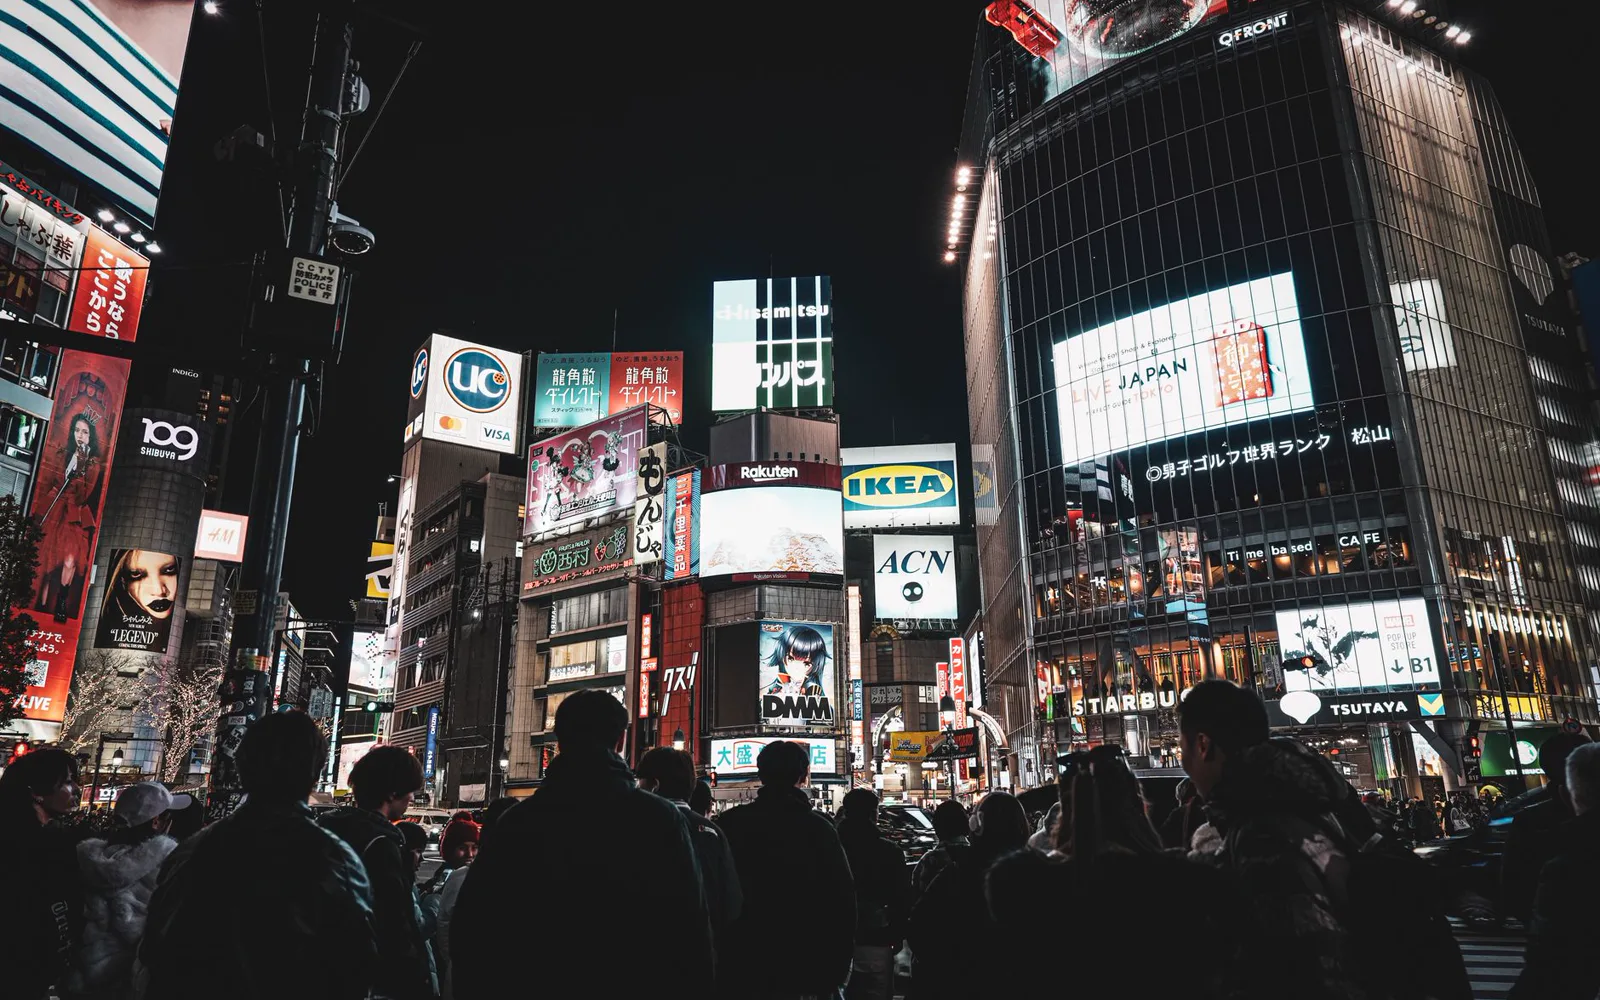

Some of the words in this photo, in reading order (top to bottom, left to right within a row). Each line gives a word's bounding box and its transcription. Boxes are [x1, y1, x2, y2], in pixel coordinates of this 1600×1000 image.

[1218, 13, 1288, 46] QFRONT
[295, 269, 334, 283] 防犯カメラ
[297, 262, 335, 276] CCTV
[86, 248, 114, 333] ここから
[293, 285, 331, 299] 警視庁
[294, 278, 333, 291] POLICE
[104, 257, 134, 340] 歌うなら
[1525, 313, 1567, 338] TSUTAYA
[172, 367, 199, 379] INDIGO
[552, 367, 596, 386] 龍角散
[625, 366, 669, 385] 龍角散
[1071, 378, 1112, 404] LIVE
[1118, 357, 1188, 390] JAPAN
[545, 387, 602, 405] ダイレクト
[619, 386, 676, 404] ダイレクト
[142, 417, 199, 461] 109
[483, 427, 511, 442] VISA
[1350, 424, 1392, 446] 松山
[140, 446, 176, 460] SHIBUYA
[740, 464, 799, 480] Rakuten
[848, 474, 946, 497] IKEA
[636, 448, 664, 559] もんじゃ
[673, 477, 689, 572] 三千里薬品
[1227, 549, 1264, 562] Time
[1270, 540, 1313, 556] based
[1339, 532, 1380, 547] CAFE
[876, 550, 952, 574] ACN
[952, 645, 964, 694] カラオケ
[1411, 657, 1433, 673] B1
[763, 695, 833, 719] DMM
[1330, 701, 1408, 716] TSUTAYA
[717, 744, 828, 766] 大盛店
